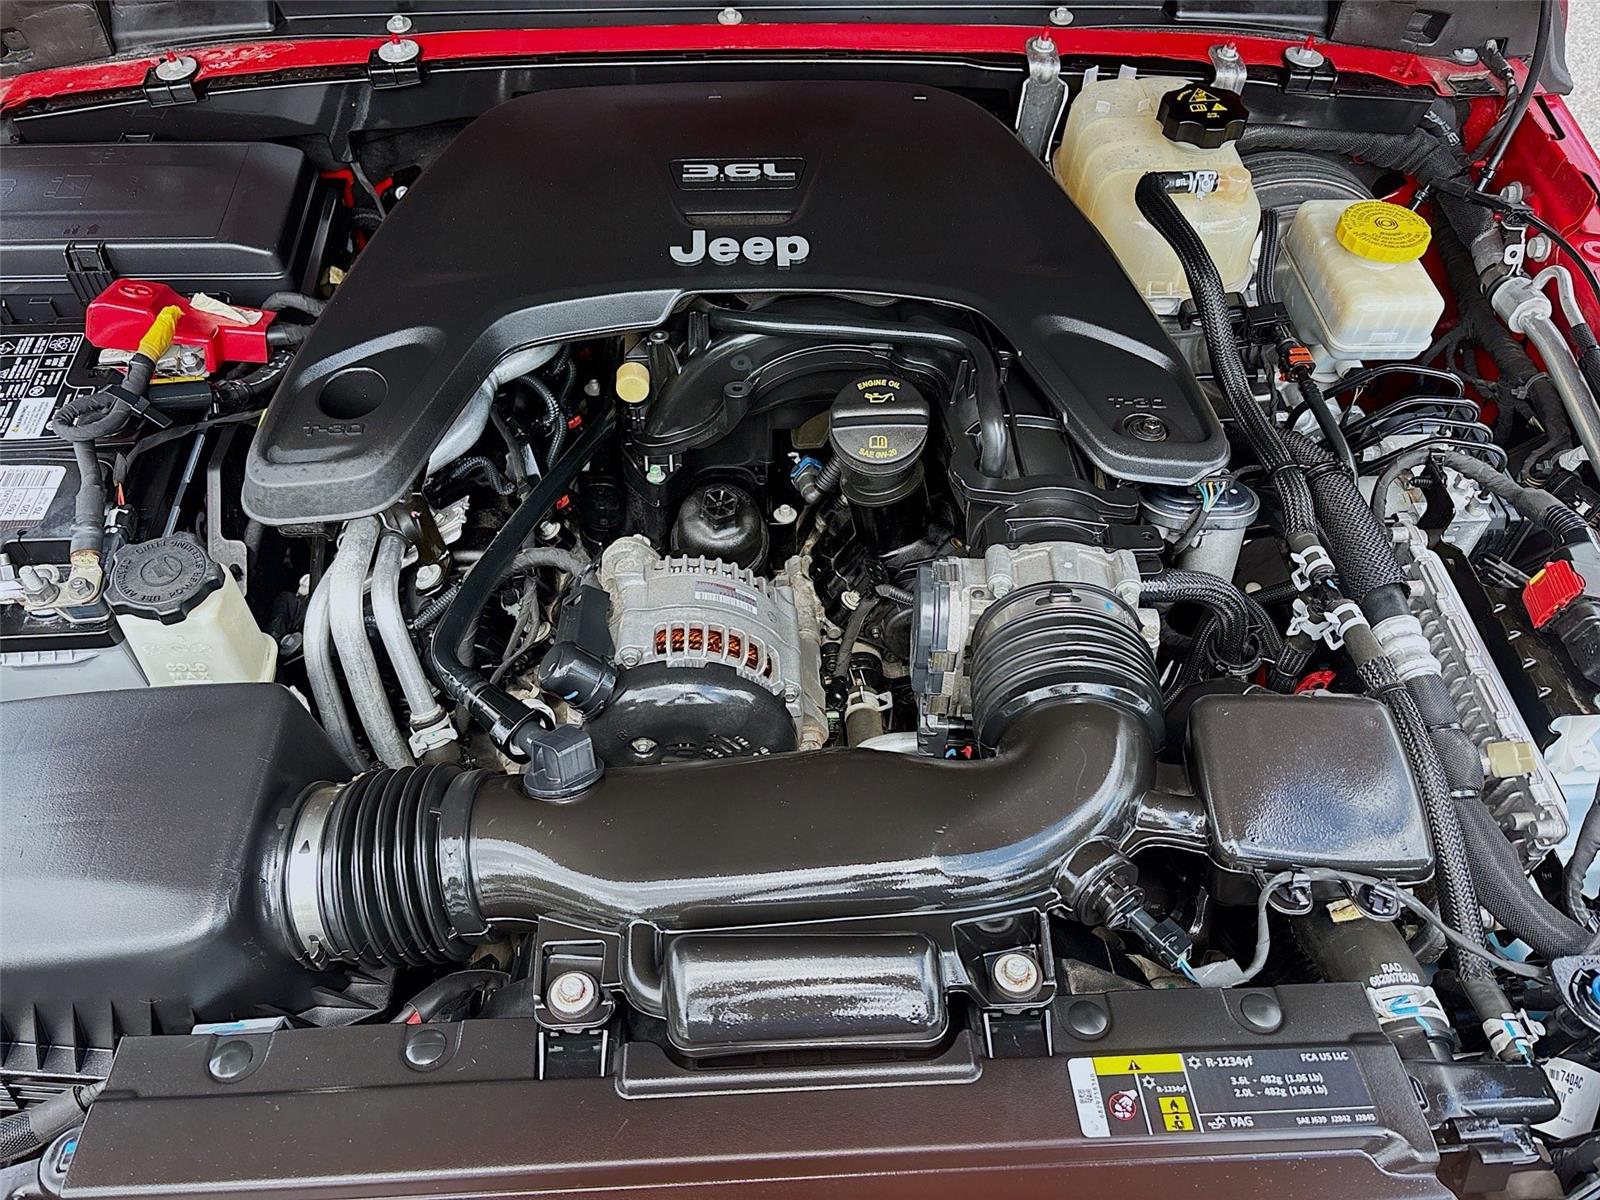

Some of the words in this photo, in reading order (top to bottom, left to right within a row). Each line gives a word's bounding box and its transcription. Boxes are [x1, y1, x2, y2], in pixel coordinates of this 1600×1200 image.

[682, 163, 796, 182] 3.6L
[669, 229, 810, 270] Jeep
[856, 379, 887, 390] ENGINE
[888, 380, 901, 389] OIL
[858, 447, 874, 457] SAE
[875, 448, 897, 458] 0W-20
[1380, 962, 1402, 974] RAD
[1205, 1055, 1253, 1069] R-1234yf
[1300, 1052, 1319, 1062] FCA
[1319, 1052, 1332, 1061] US
[1332, 1051, 1349, 1061] LLC
[1230, 1076, 1251, 1085] 3.6L
[1260, 1075, 1283, 1085] 482g
[1308, 1072, 1324, 1083] Lb)
[1560, 1069, 1584, 1089] 740AC
[1234, 1088, 1255, 1097] 2.0L
[1264, 1087, 1287, 1097] 482g
[1312, 1084, 1328, 1096] Lb)
[1229, 1116, 1254, 1127] PAG
[1296, 1116, 1311, 1125] SAE
